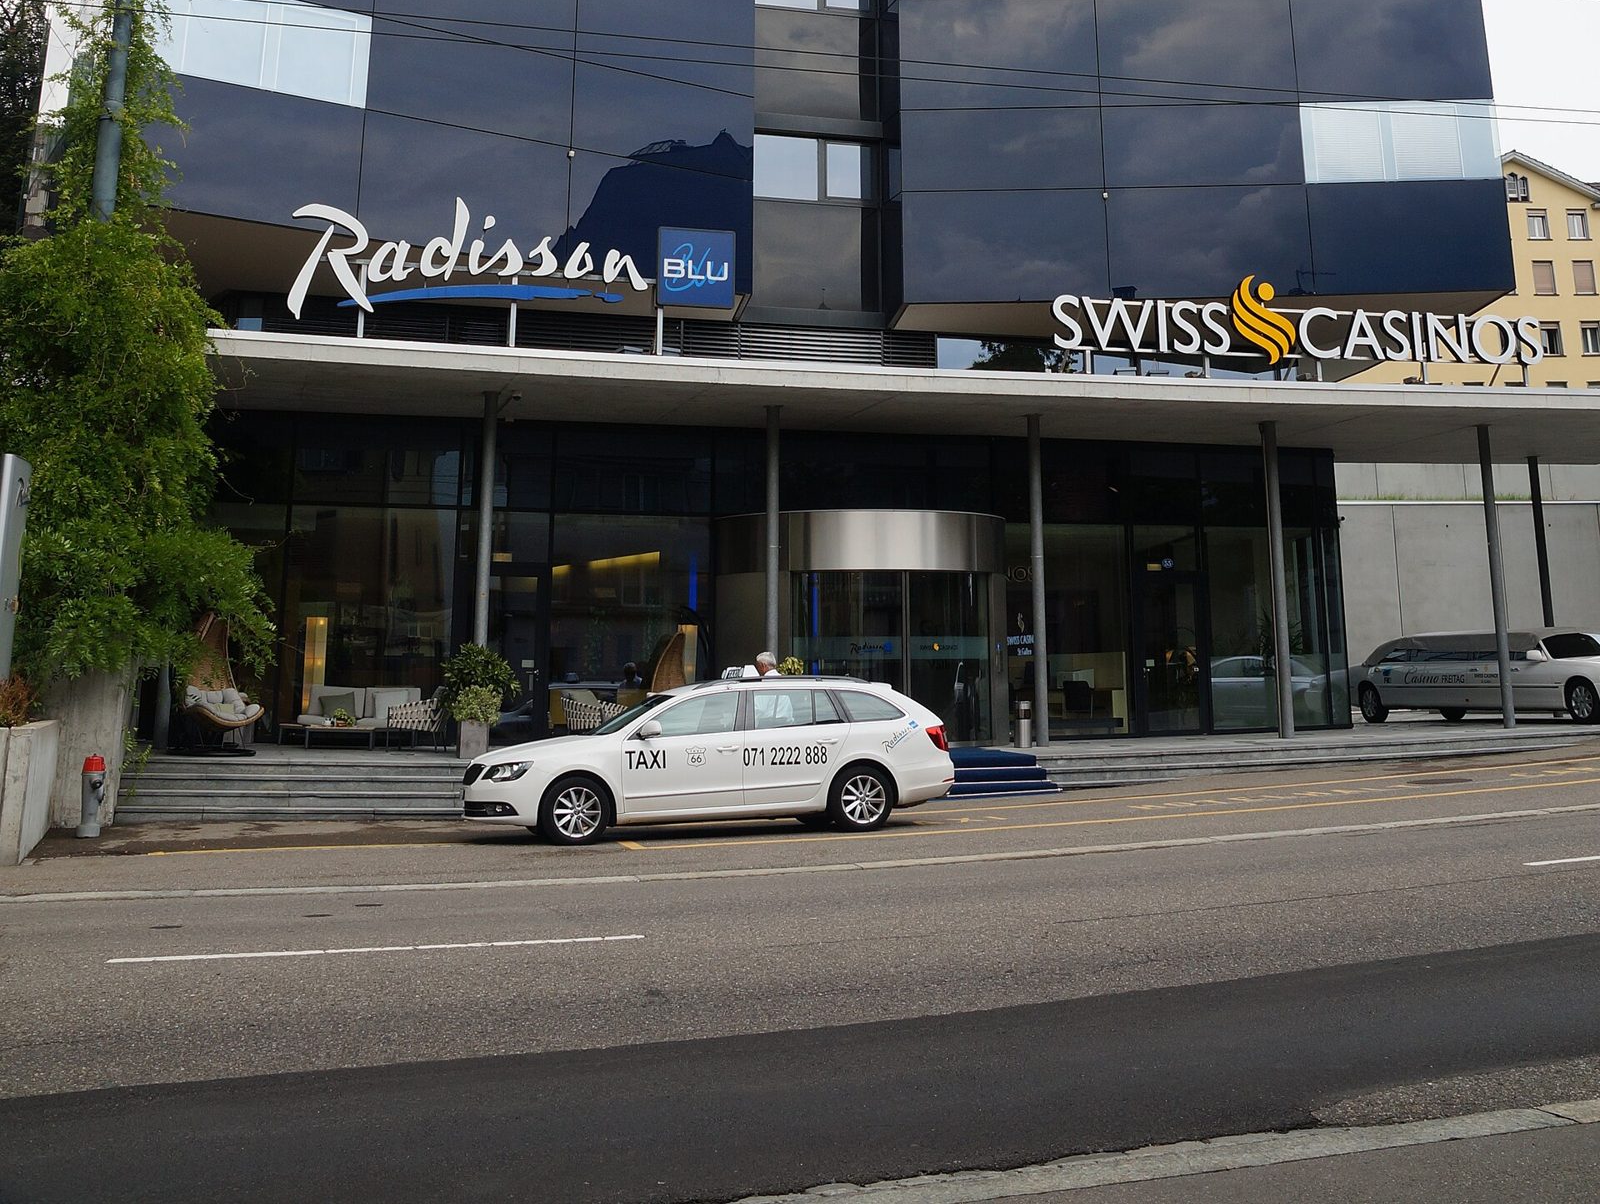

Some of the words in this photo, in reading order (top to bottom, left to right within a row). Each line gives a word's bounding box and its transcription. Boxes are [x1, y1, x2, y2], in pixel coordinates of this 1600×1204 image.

[287, 196, 648, 320] Radisson
[663, 257, 729, 282] BLU
[1051, 294, 1231, 356] SWISS
[1298, 306, 1545, 365] CASINOS
[1404, 666, 1439, 684] Casino
[1441, 674, 1465, 684] FREITAG
[625, 750, 667, 770] TAXI
[690, 754, 703, 764] 66
[743, 748, 765, 766] 071
[770, 747, 801, 766] 2222
[805, 746, 828, 765] 888
